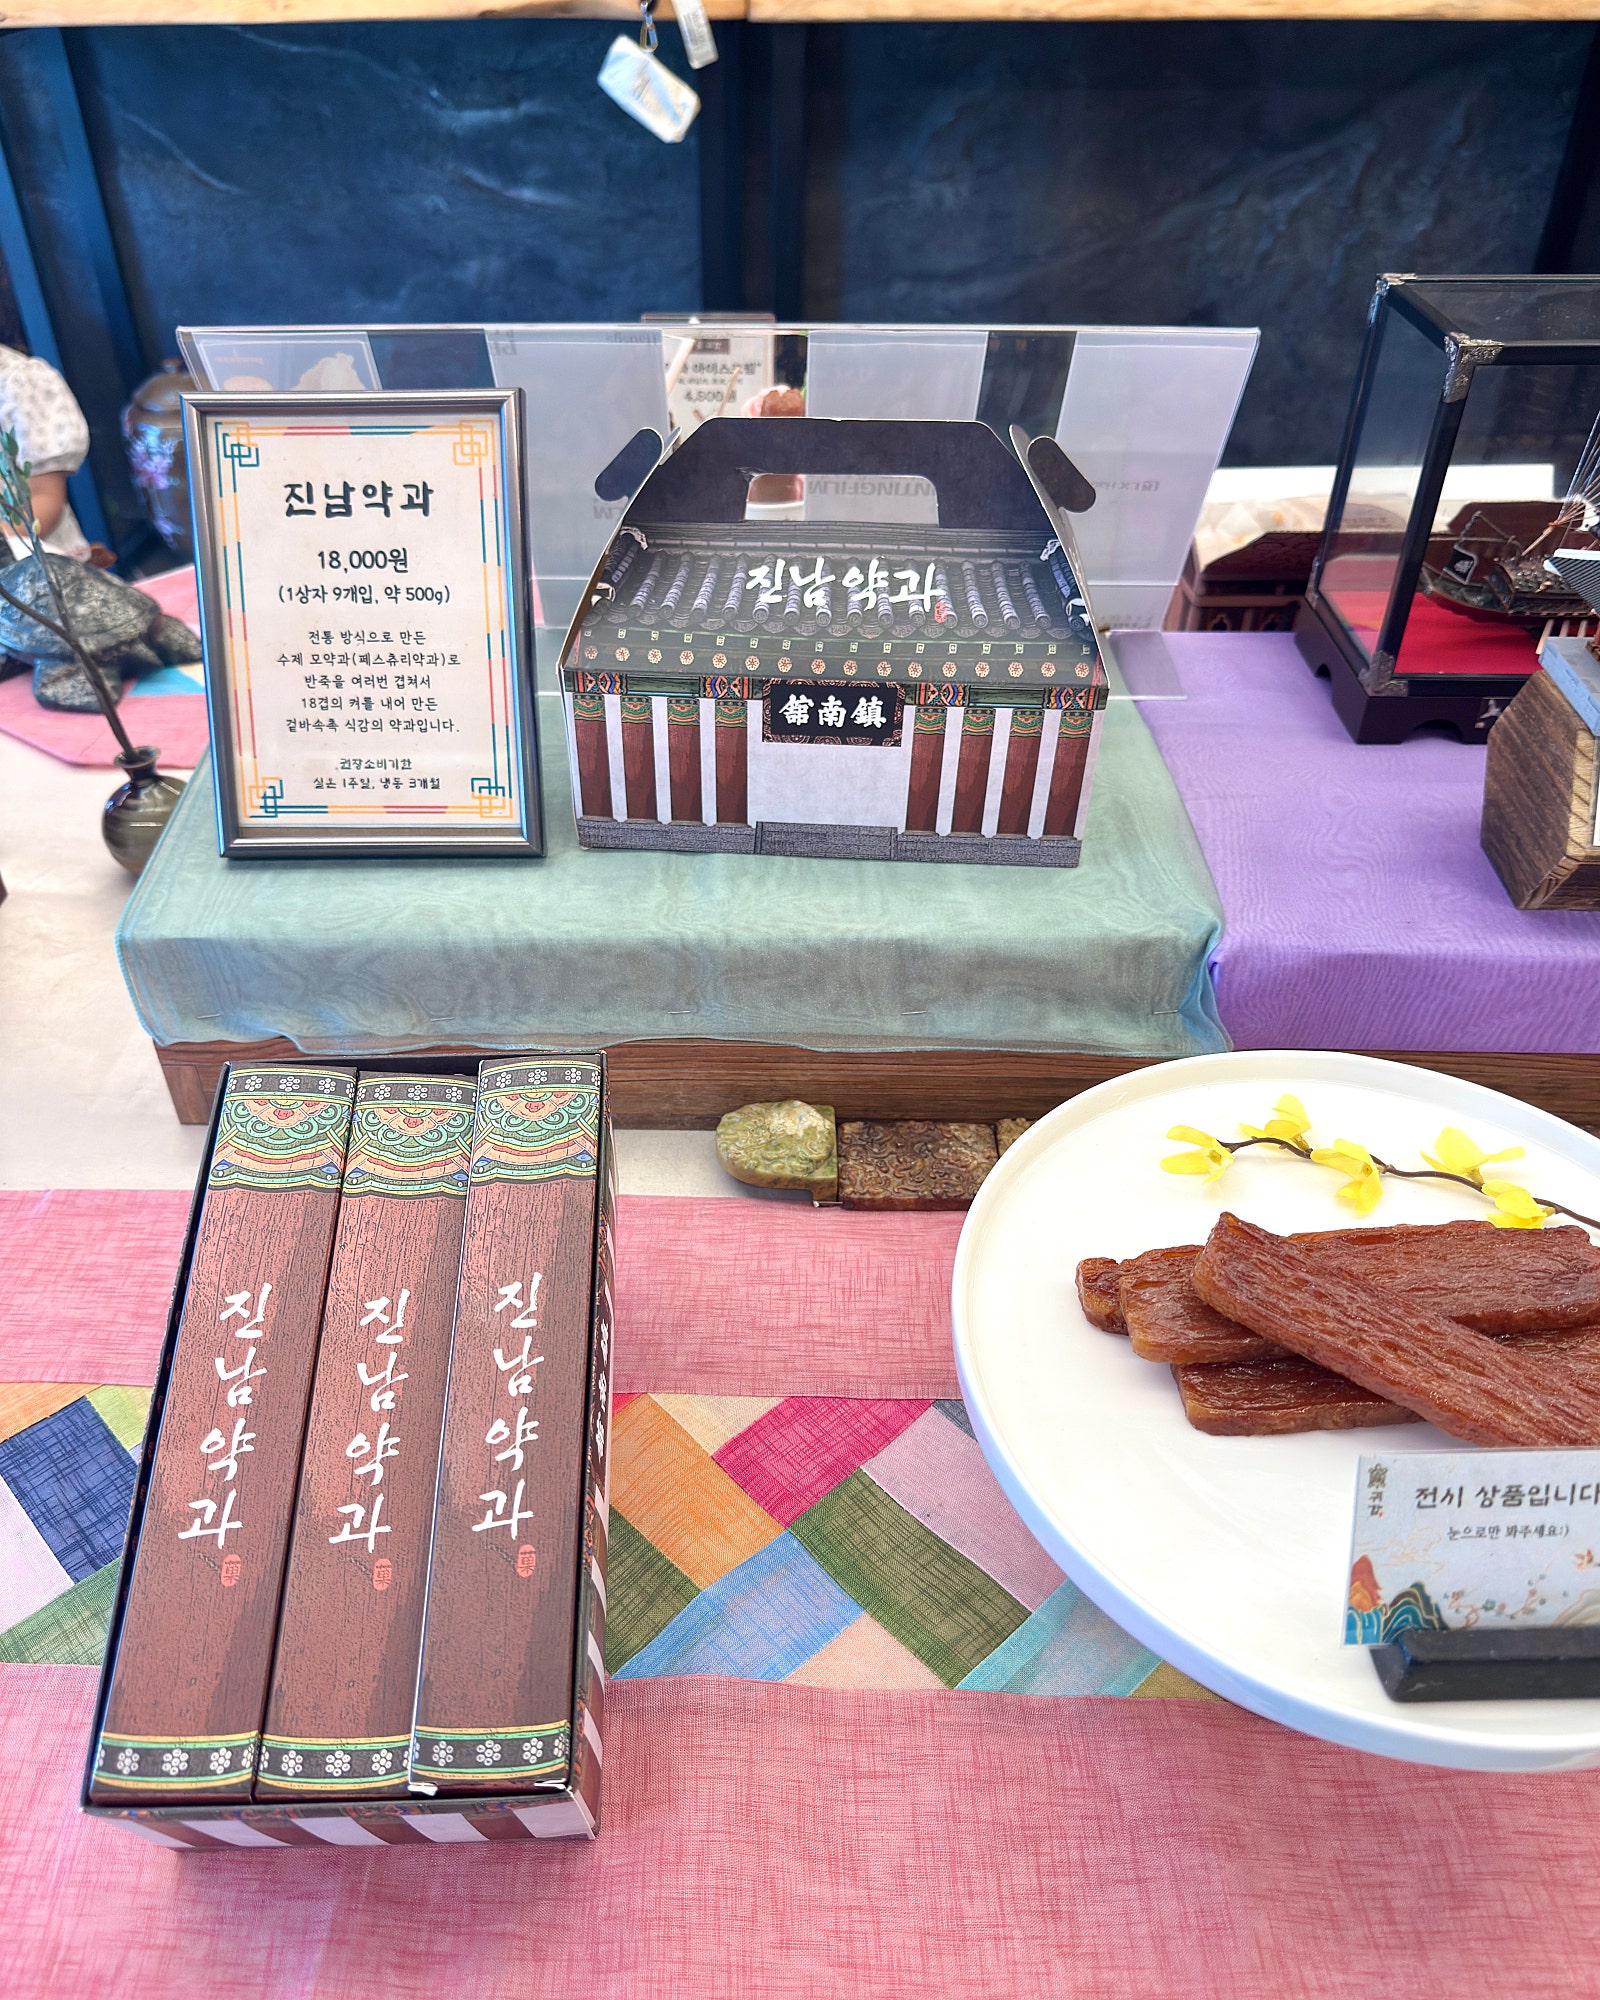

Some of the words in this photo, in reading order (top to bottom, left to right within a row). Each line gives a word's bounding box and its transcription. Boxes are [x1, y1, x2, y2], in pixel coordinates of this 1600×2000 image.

[283, 480, 434, 519] 진남약과
[317, 547, 409, 574] 18,000원
[278, 584, 328, 604] (1상자
[332, 585, 379, 604] 9개입,
[384, 585, 401, 604] 약
[405, 585, 451, 605] 500g)
[746, 556, 947, 613] 진남약과
[308, 630, 334, 645] 전통
[340, 630, 394, 645] 방식으로
[399, 630, 427, 645] 만든
[277, 653, 304, 666] 수제
[309, 652, 461, 667] 모약과(페스츄리약과)로
[304, 675, 346, 689] 반죽을
[351, 675, 389, 689] 여러번
[394, 675, 432, 689] 겹쳐서
[301, 697, 344, 711] 18겹의
[349, 697, 375, 712] 켜를
[381, 697, 406, 711] 내어
[411, 697, 438, 712] 만든
[286, 718, 340, 733] 겉바속촉
[345, 718, 384, 733] 식감의
[389, 718, 460, 733] 약과입니다.
[408, 777, 441, 790] 3개월
[178, 1282, 273, 1550] 진남약과
[471, 1271, 545, 1541] 진남약과
[328, 1288, 409, 1554] 진남약과
[1415, 1486, 1464, 1509] 전시
[1475, 1483, 1600, 1509] 상품입니다
[1447, 1526, 1501, 1541] 눈으로만
